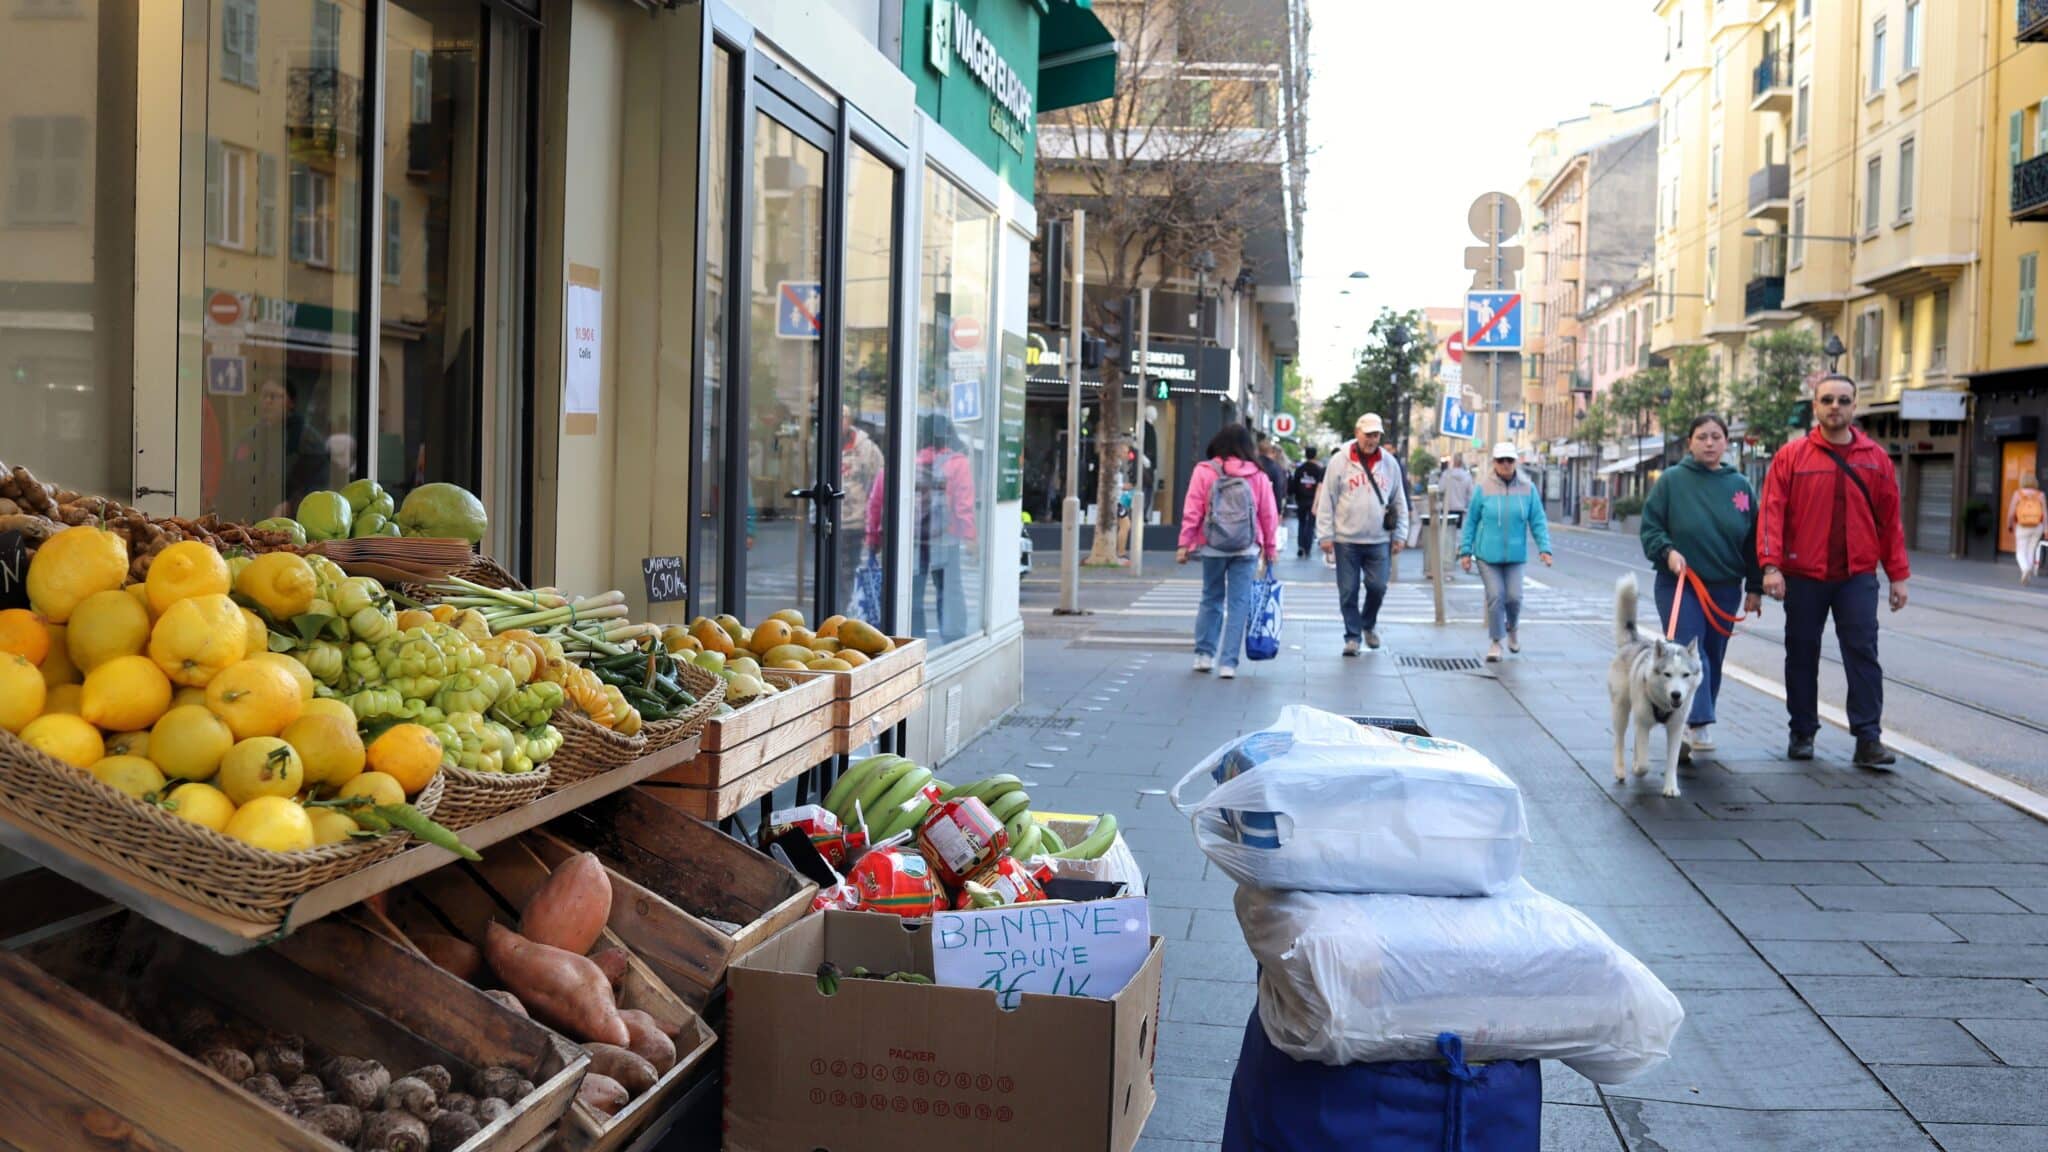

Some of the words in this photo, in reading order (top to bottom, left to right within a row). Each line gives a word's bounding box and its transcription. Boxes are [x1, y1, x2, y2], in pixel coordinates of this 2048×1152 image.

[954, 1, 997, 94] VIAGER
[997, 55, 1032, 134] EUROPE
[1276, 418, 1292, 432] U
[940, 907, 1121, 949] BANANE
[983, 946, 1089, 972] JAUNE
[888, 1047, 936, 1064] PACKER
